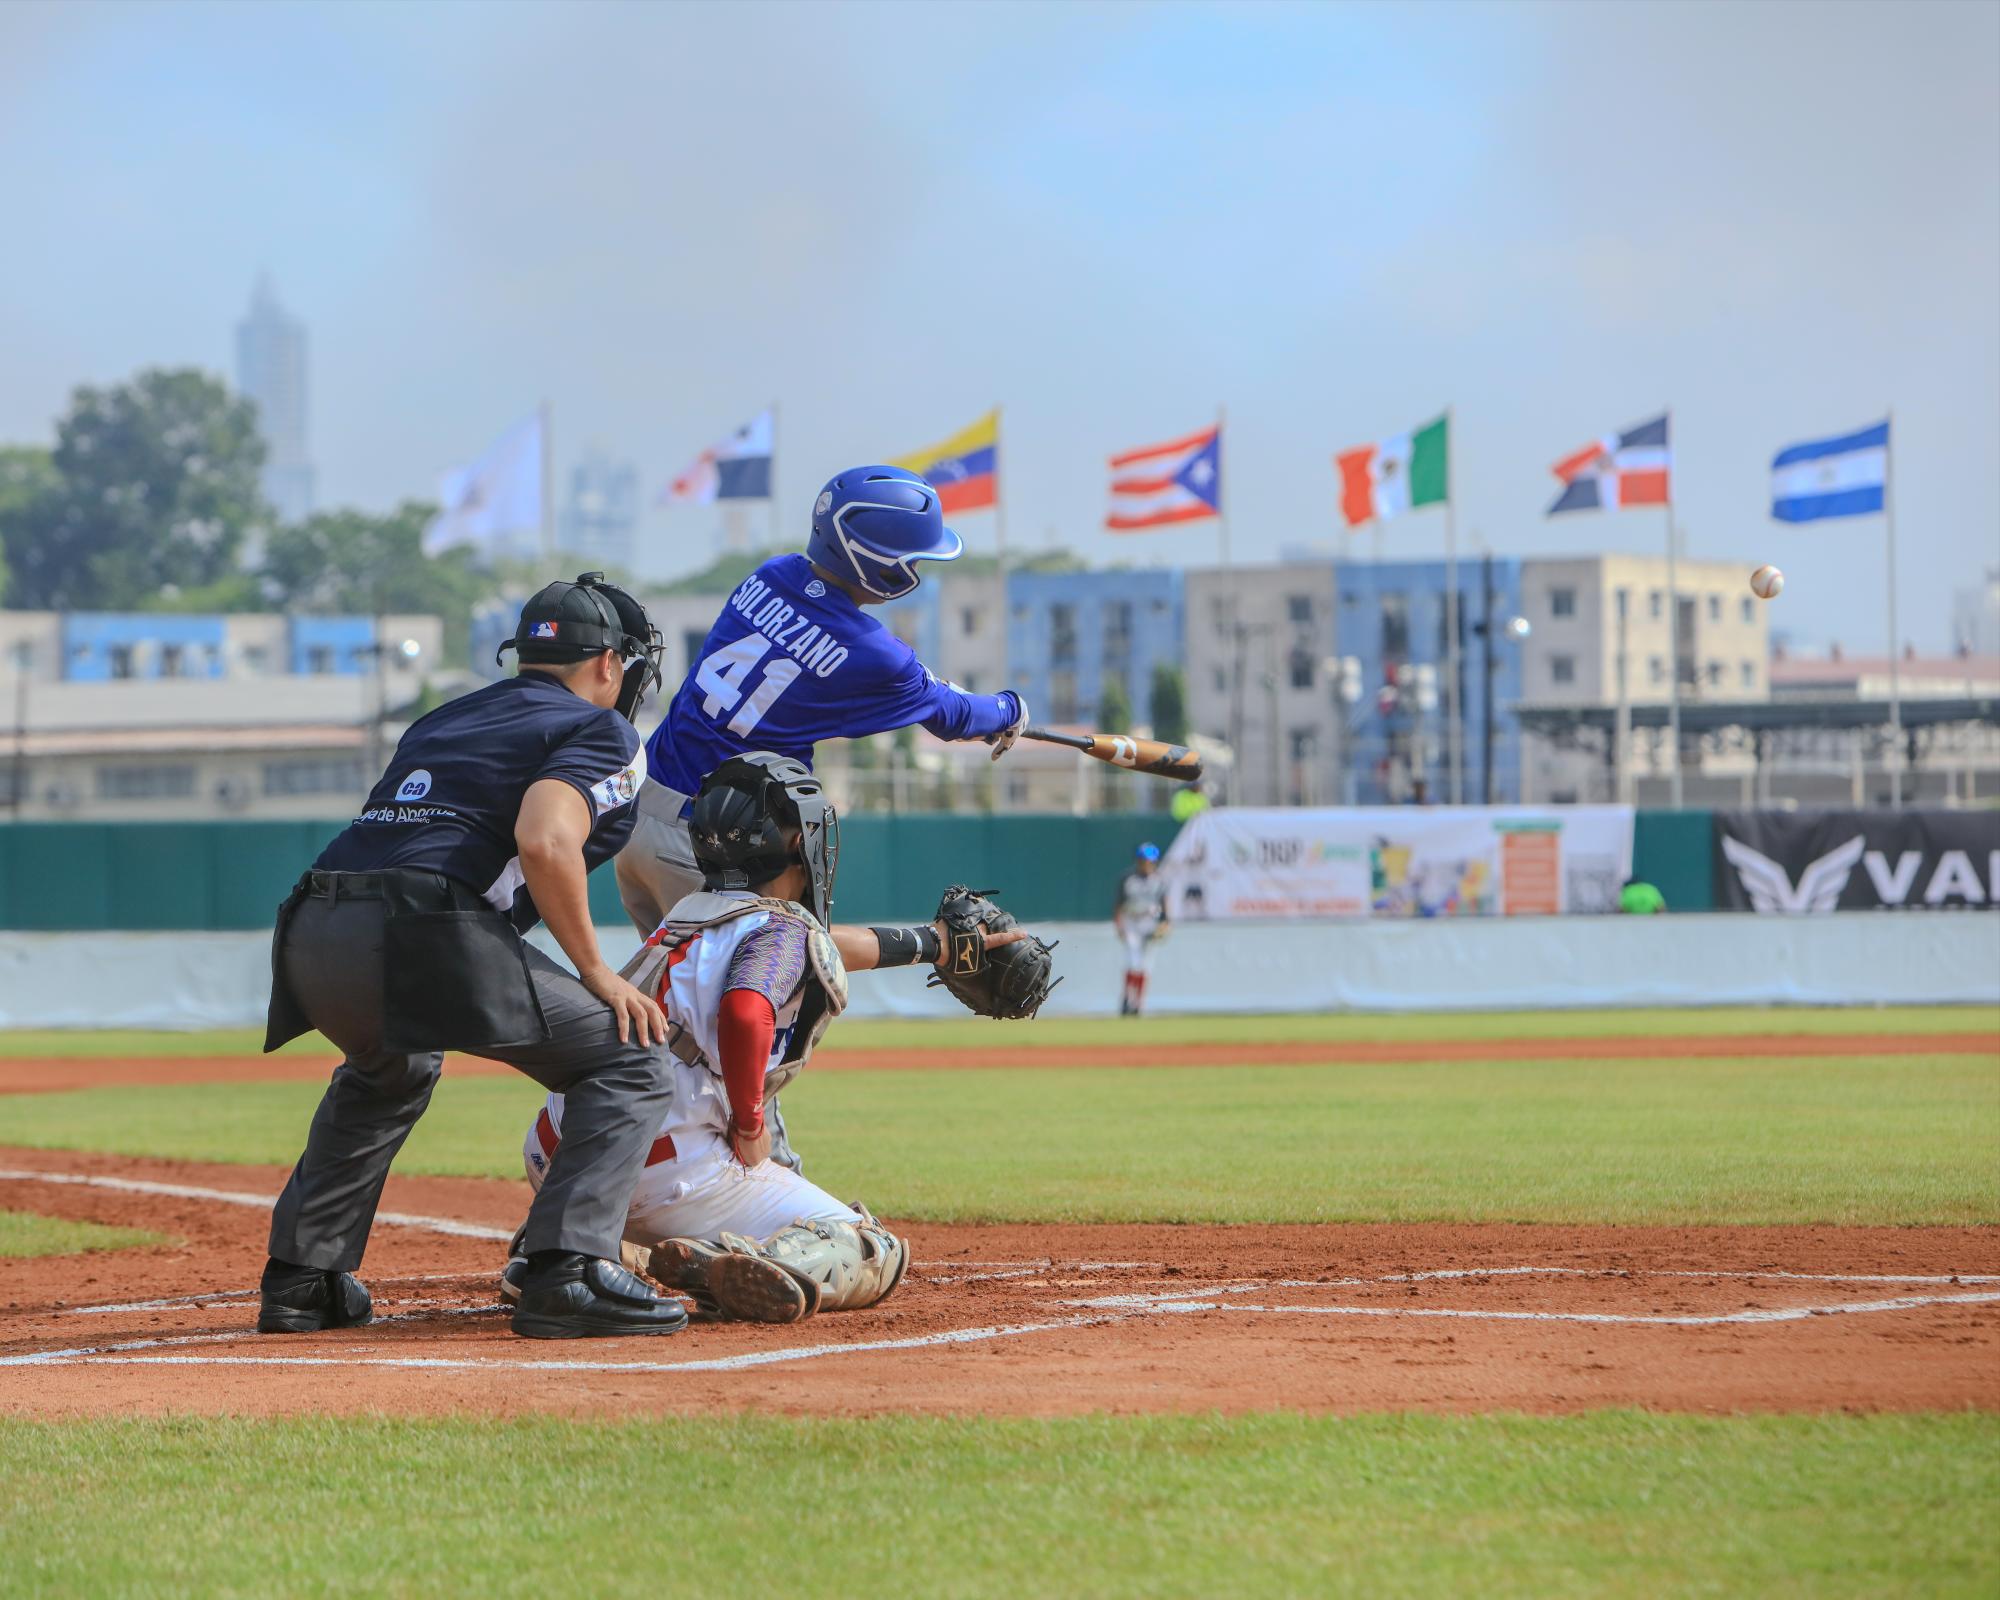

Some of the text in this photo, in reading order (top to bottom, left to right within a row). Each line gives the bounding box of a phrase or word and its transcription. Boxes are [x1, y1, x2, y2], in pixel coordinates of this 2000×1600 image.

[732, 574, 848, 678] SOLORZANO
[695, 632, 802, 739] 41
[378, 806, 394, 822] de
[402, 783, 426, 796] ca
